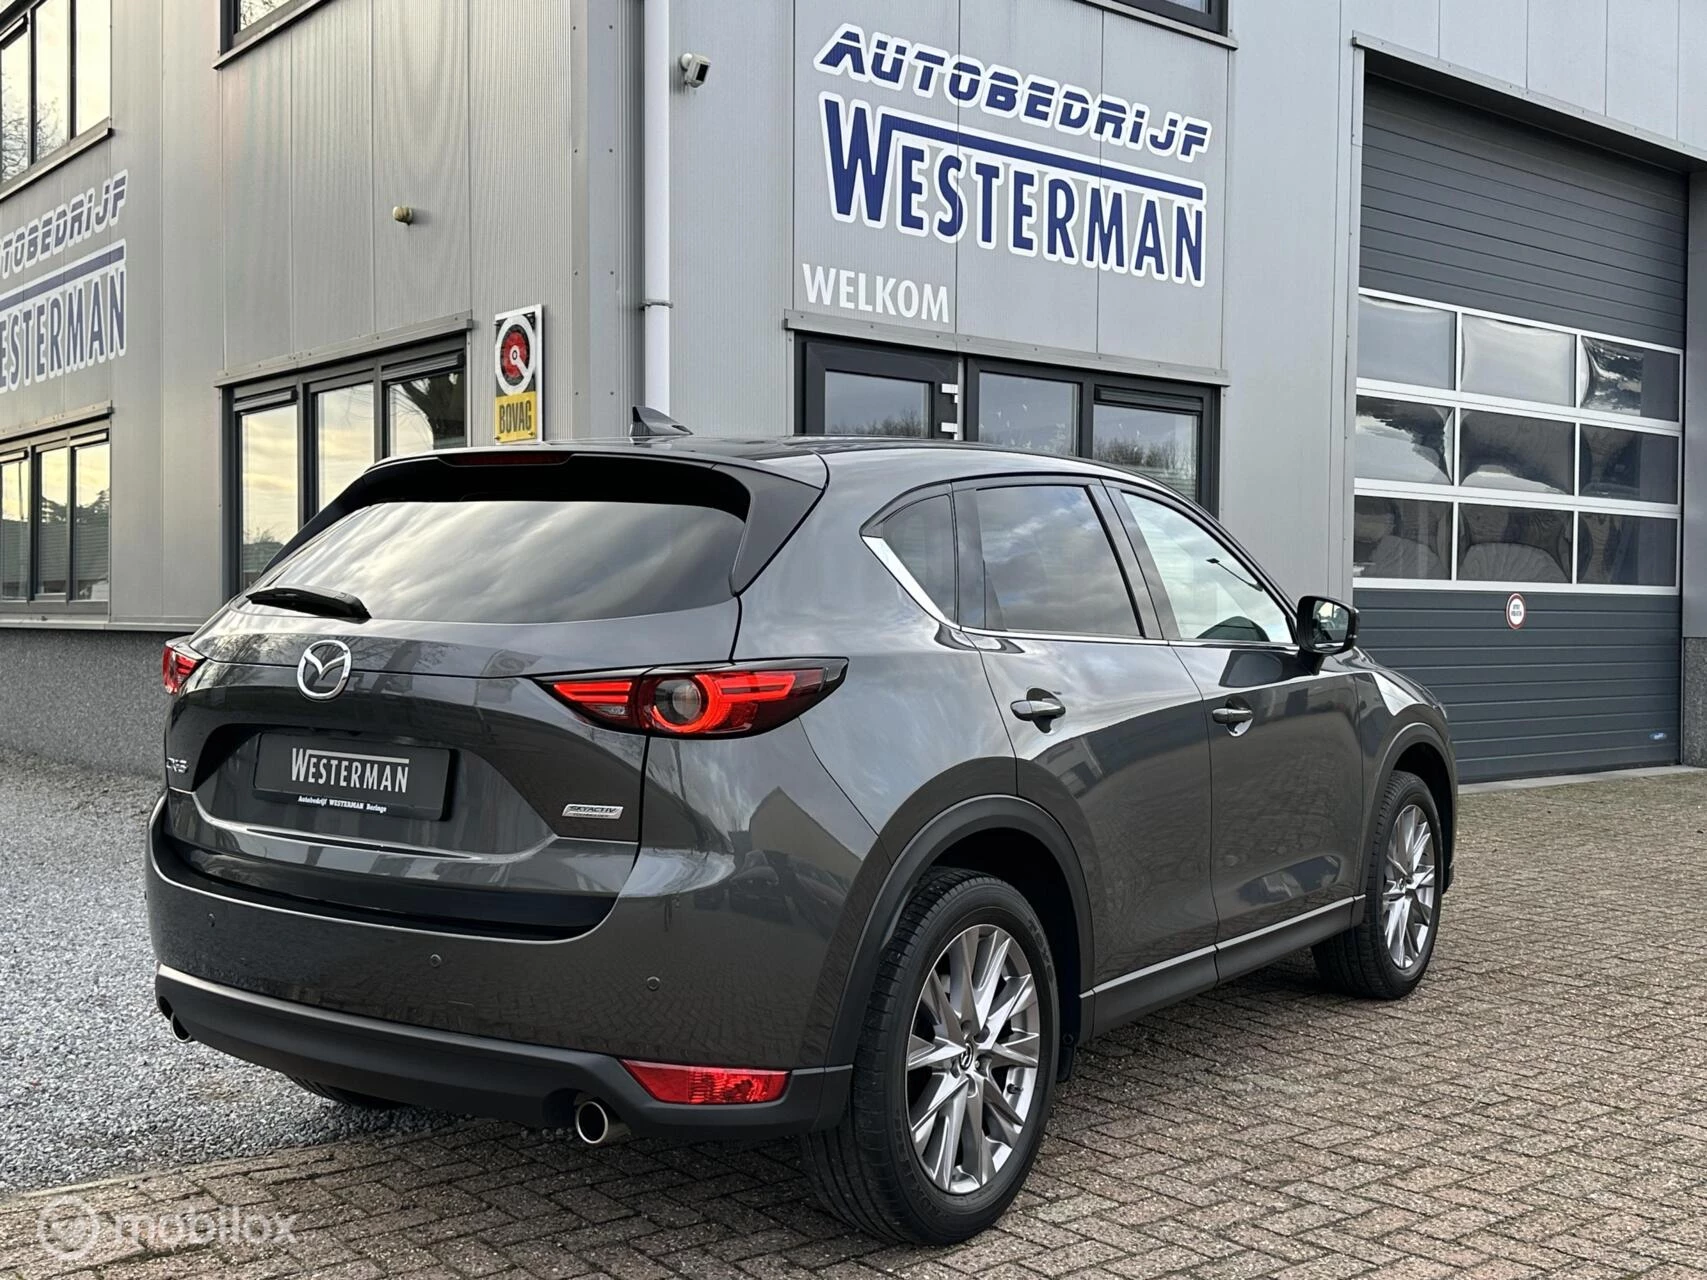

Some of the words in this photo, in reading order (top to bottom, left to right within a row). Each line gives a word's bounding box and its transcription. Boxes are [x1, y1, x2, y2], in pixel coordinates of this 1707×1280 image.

[816, 26, 1211, 160] AUTOBEDRIJF
[0, 172, 127, 277] TOBEDRIJF
[821, 94, 1205, 285] WESTERMAN
[0, 246, 125, 390] ESTERMAN
[802, 263, 949, 323] WELKOM
[499, 400, 532, 433] BOVAG
[292, 747, 409, 793] WESTERMAN
[329, 799, 364, 809] WESTERMAN
